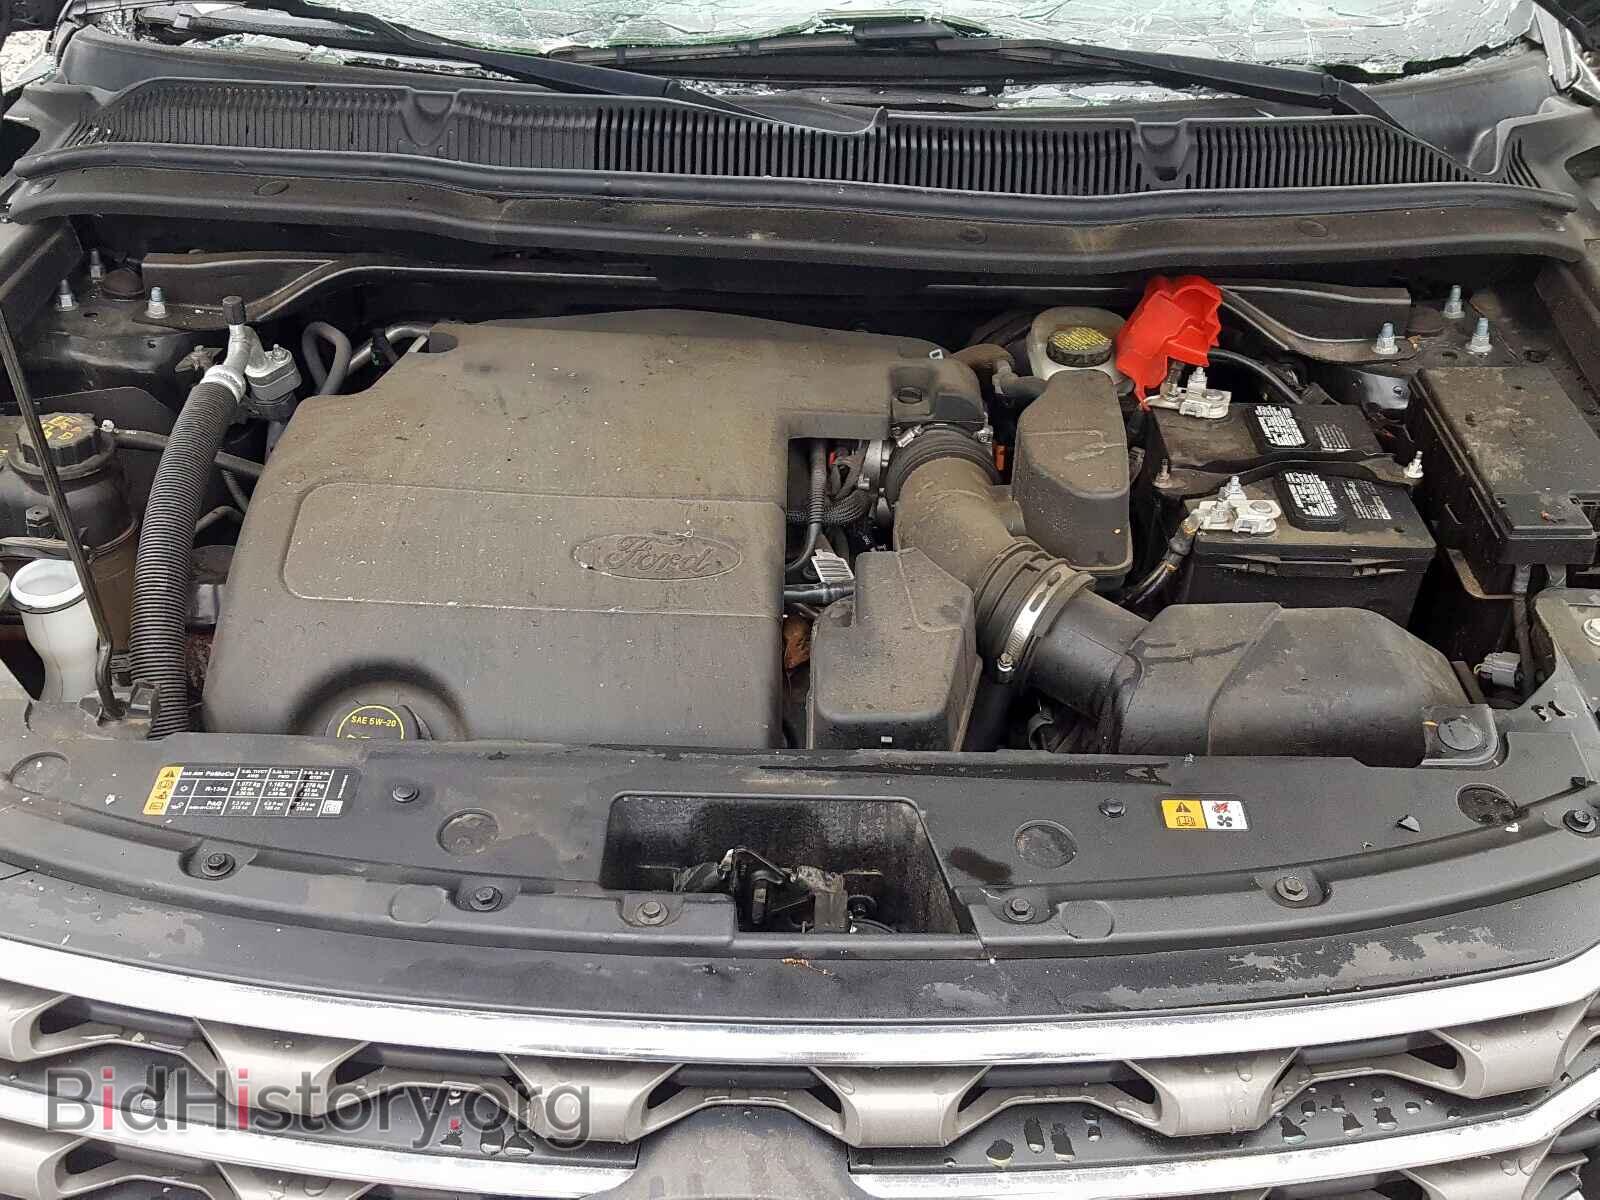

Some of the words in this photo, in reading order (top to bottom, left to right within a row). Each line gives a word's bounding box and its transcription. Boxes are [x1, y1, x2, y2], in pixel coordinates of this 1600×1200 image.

[606, 535, 713, 574] Ford
[351, 715, 368, 725] SAE
[369, 717, 397, 727] 5W-20
